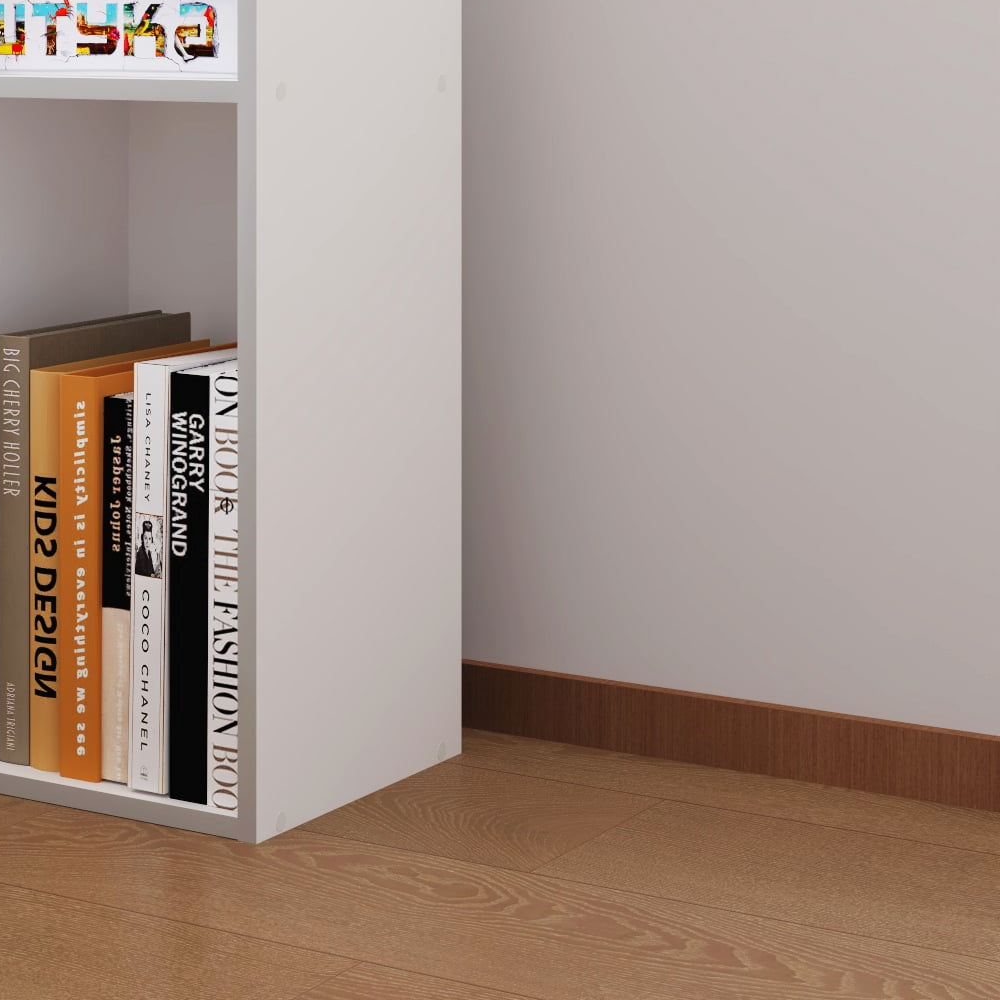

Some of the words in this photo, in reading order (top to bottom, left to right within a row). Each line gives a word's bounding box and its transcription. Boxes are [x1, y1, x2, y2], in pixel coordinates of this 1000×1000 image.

[2, 348, 21, 373] BIG
[2, 379, 21, 436] CHERRY
[2, 441, 21, 497] HOLLER
[171, 411, 188, 557] WINOGRAND
[188, 413, 205, 493] GARRY
[214, 528, 238, 593] THE
[141, 589, 150, 653] COCO
[213, 600, 238, 734] FASHION
[140, 664, 149, 751] CHANEL
